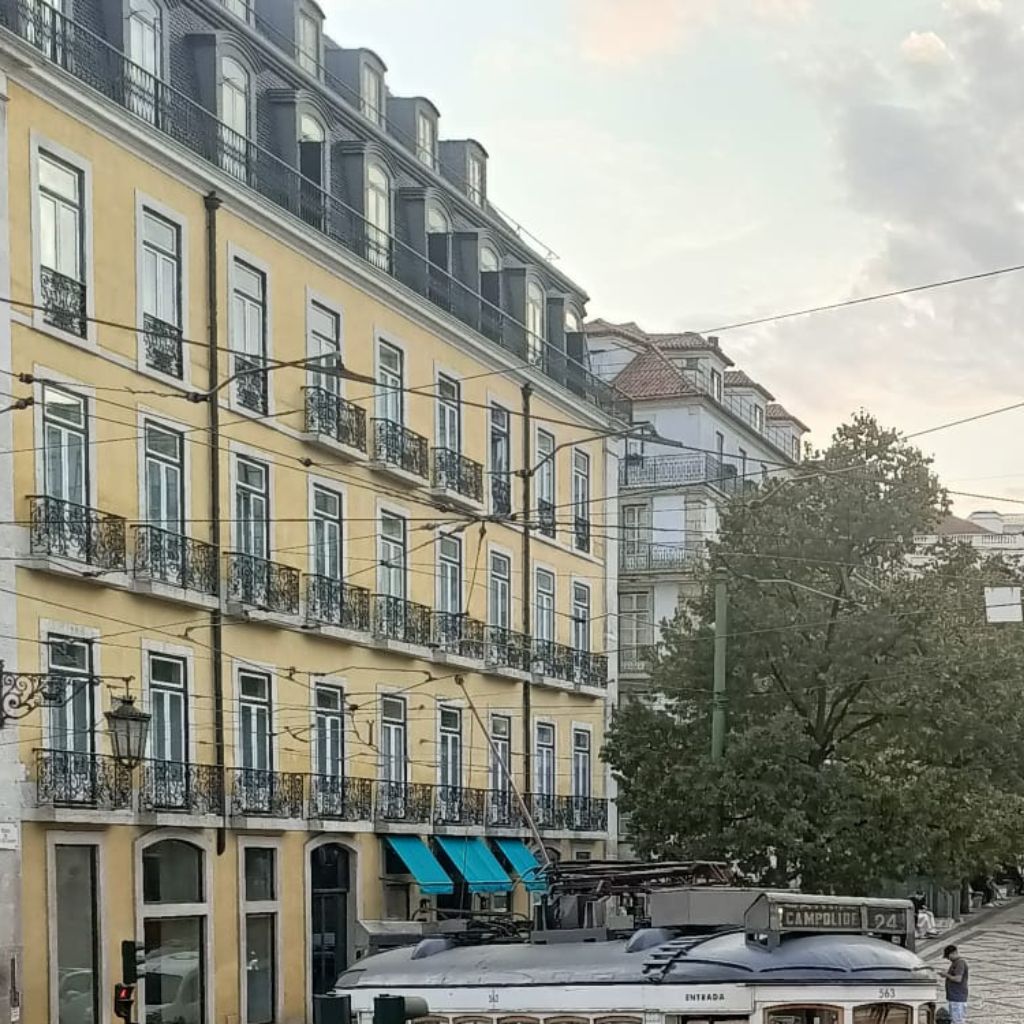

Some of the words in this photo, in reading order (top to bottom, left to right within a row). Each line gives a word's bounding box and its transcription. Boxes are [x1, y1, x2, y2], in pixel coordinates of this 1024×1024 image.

[785, 911, 860, 926] CAMPOLIDE
[874, 913, 898, 929] 24
[684, 992, 726, 1002] ENTRADA
[878, 987, 897, 999] 563
